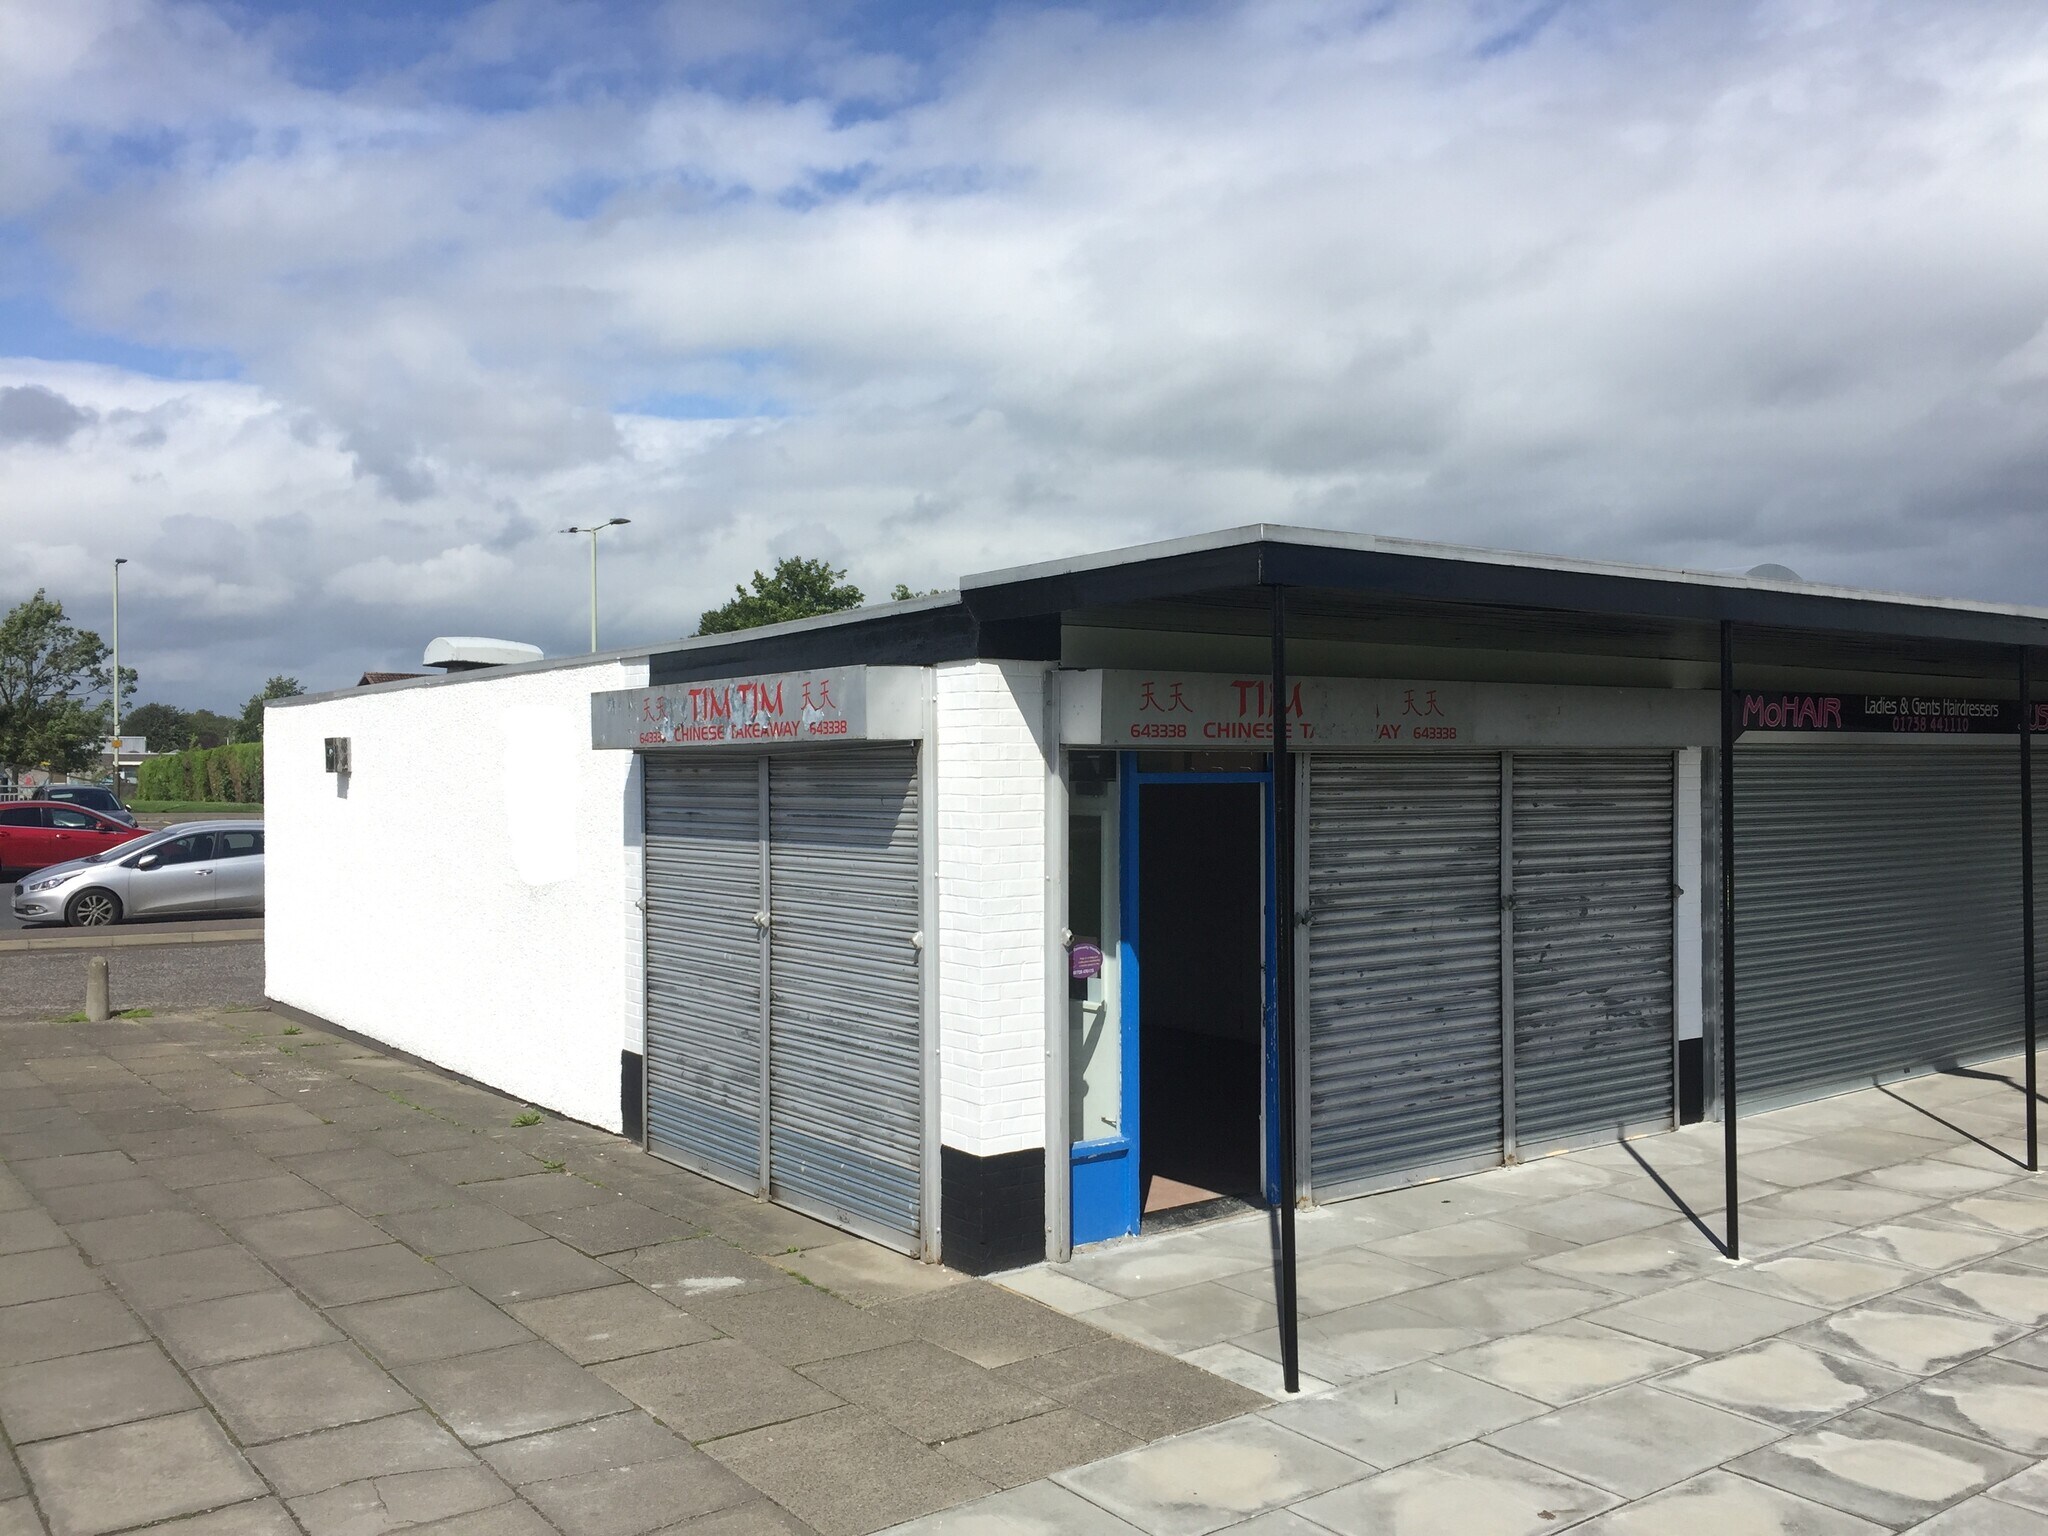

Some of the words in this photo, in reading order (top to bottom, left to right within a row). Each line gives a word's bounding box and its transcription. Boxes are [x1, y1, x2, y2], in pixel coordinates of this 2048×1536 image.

[688, 686, 731, 721] TIM
[738, 681, 784, 717] TIM
[1865, 696, 1897, 715] Ladies
[1900, 697, 1908, 715] &
[1912, 697, 1940, 716] Gents
[1942, 699, 1998, 717] Hairdressers
[675, 724, 724, 742] CHINESE
[809, 720, 847, 735] 643338
[1130, 723, 1186, 738] 643338
[1413, 726, 1457, 740] 643338
[1893, 716, 1926, 732] 01738
[1930, 717, 1968, 733] 441110
